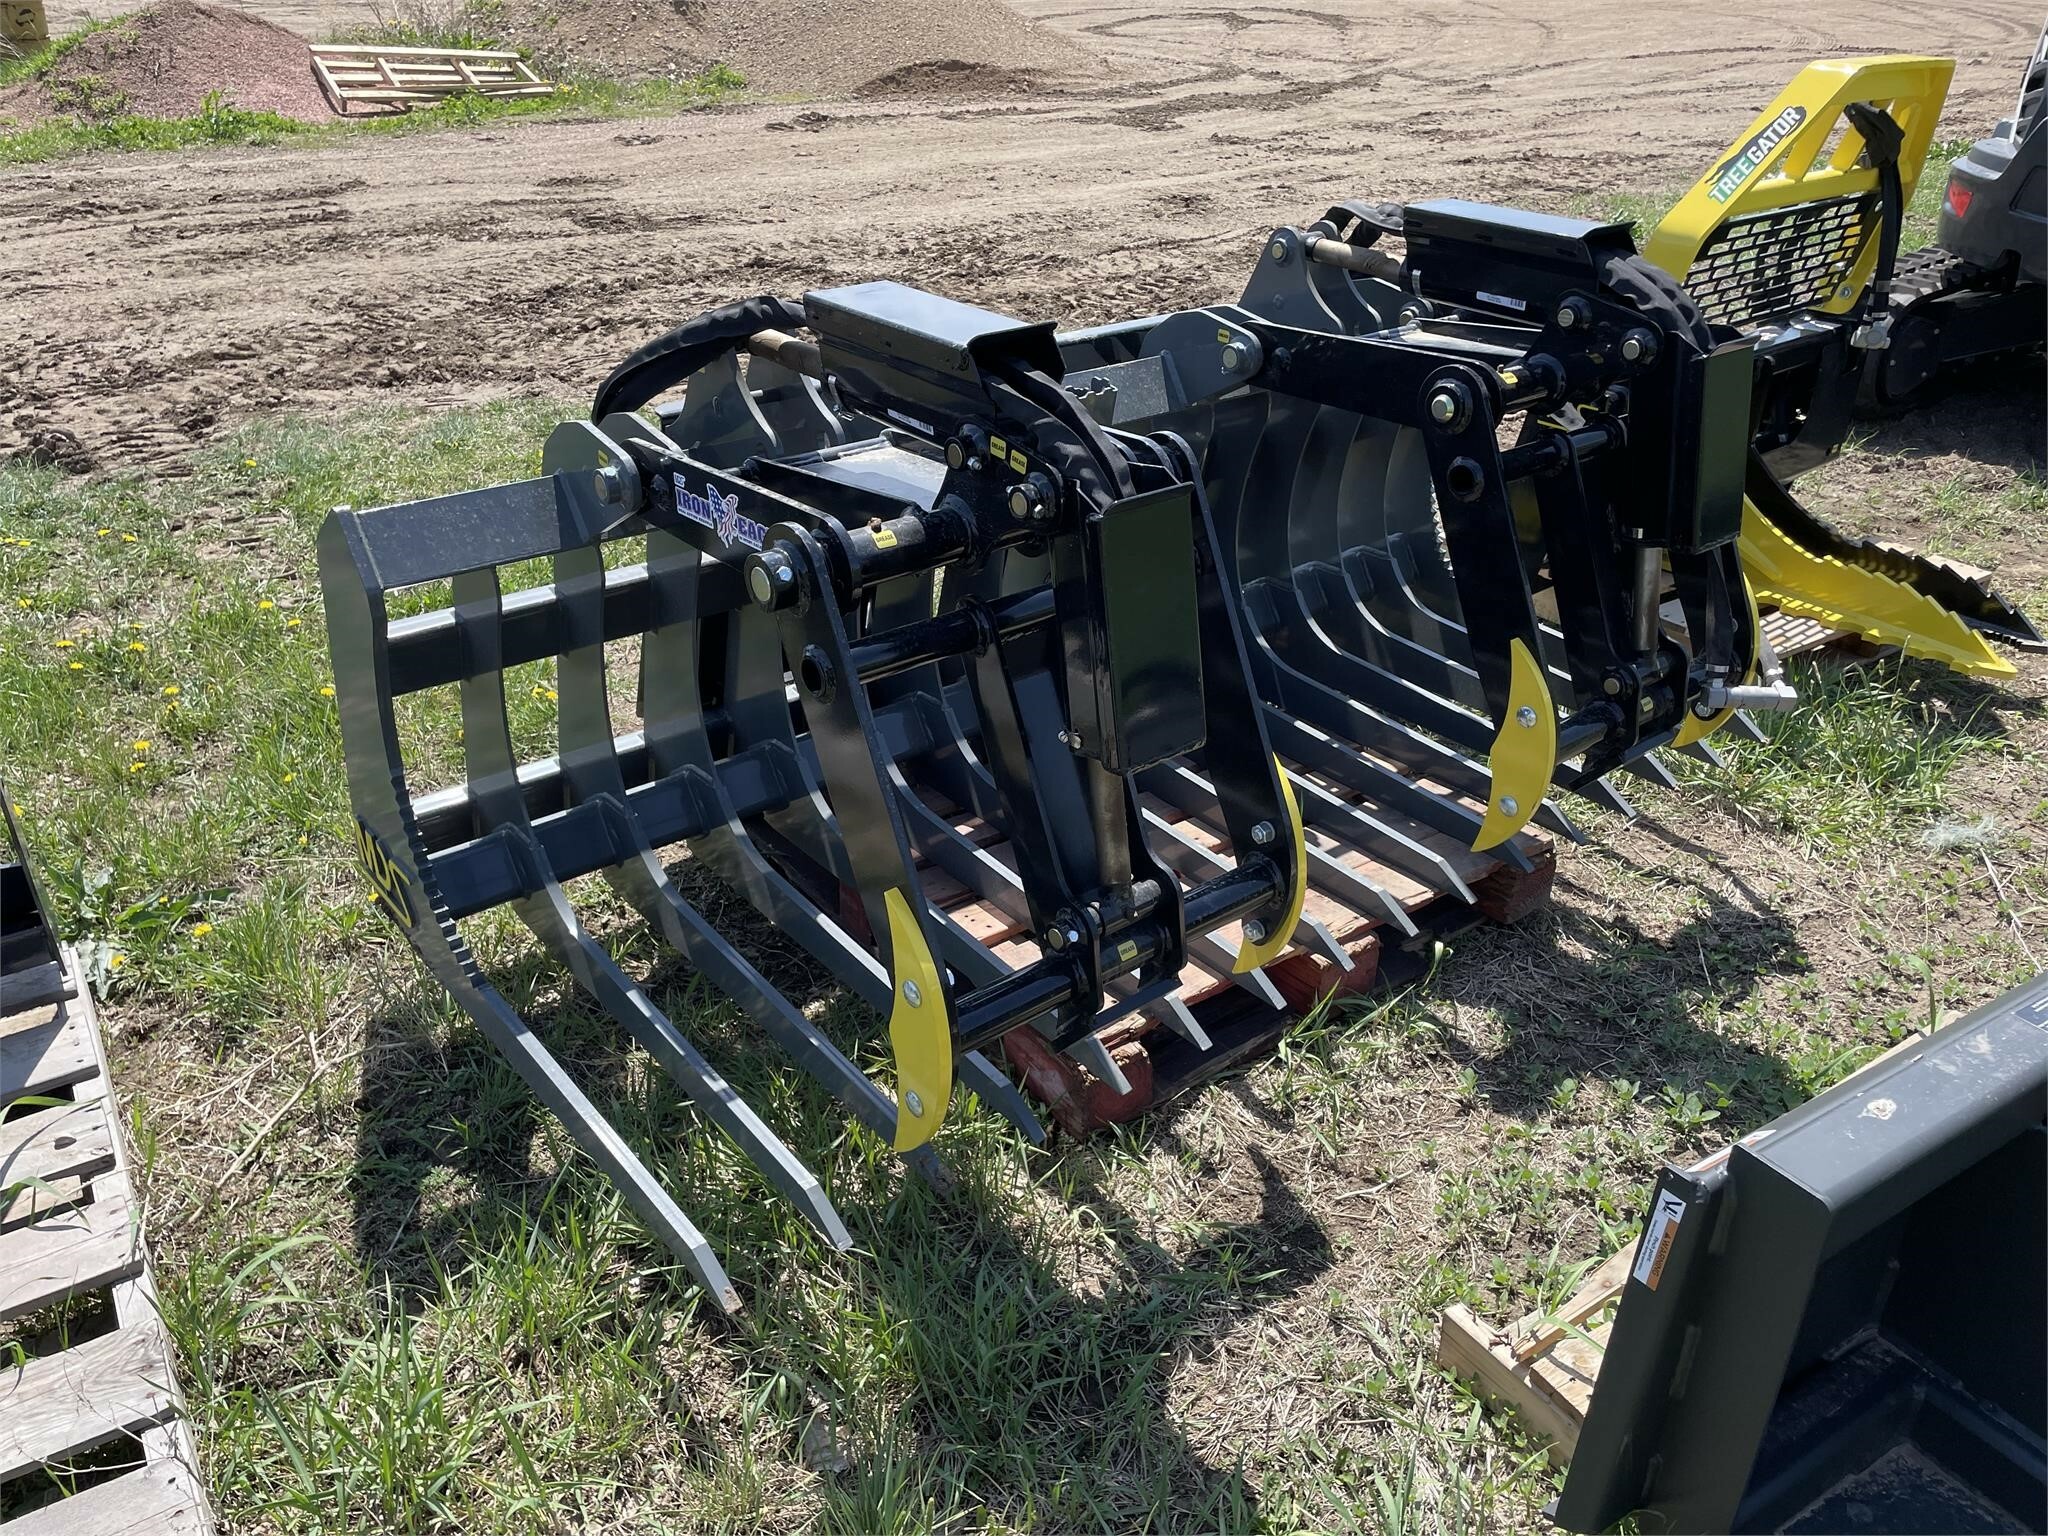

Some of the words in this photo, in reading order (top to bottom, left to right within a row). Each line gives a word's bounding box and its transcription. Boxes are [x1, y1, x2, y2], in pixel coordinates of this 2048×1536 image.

[991, 441, 1005, 453] GREASE
[1011, 455, 1026, 468] GREASE
[676, 488, 712, 521] IRON
[737, 517, 767, 541] EAG
[875, 533, 894, 543] GREASE
[1652, 1238, 1671, 1277] WARNING
